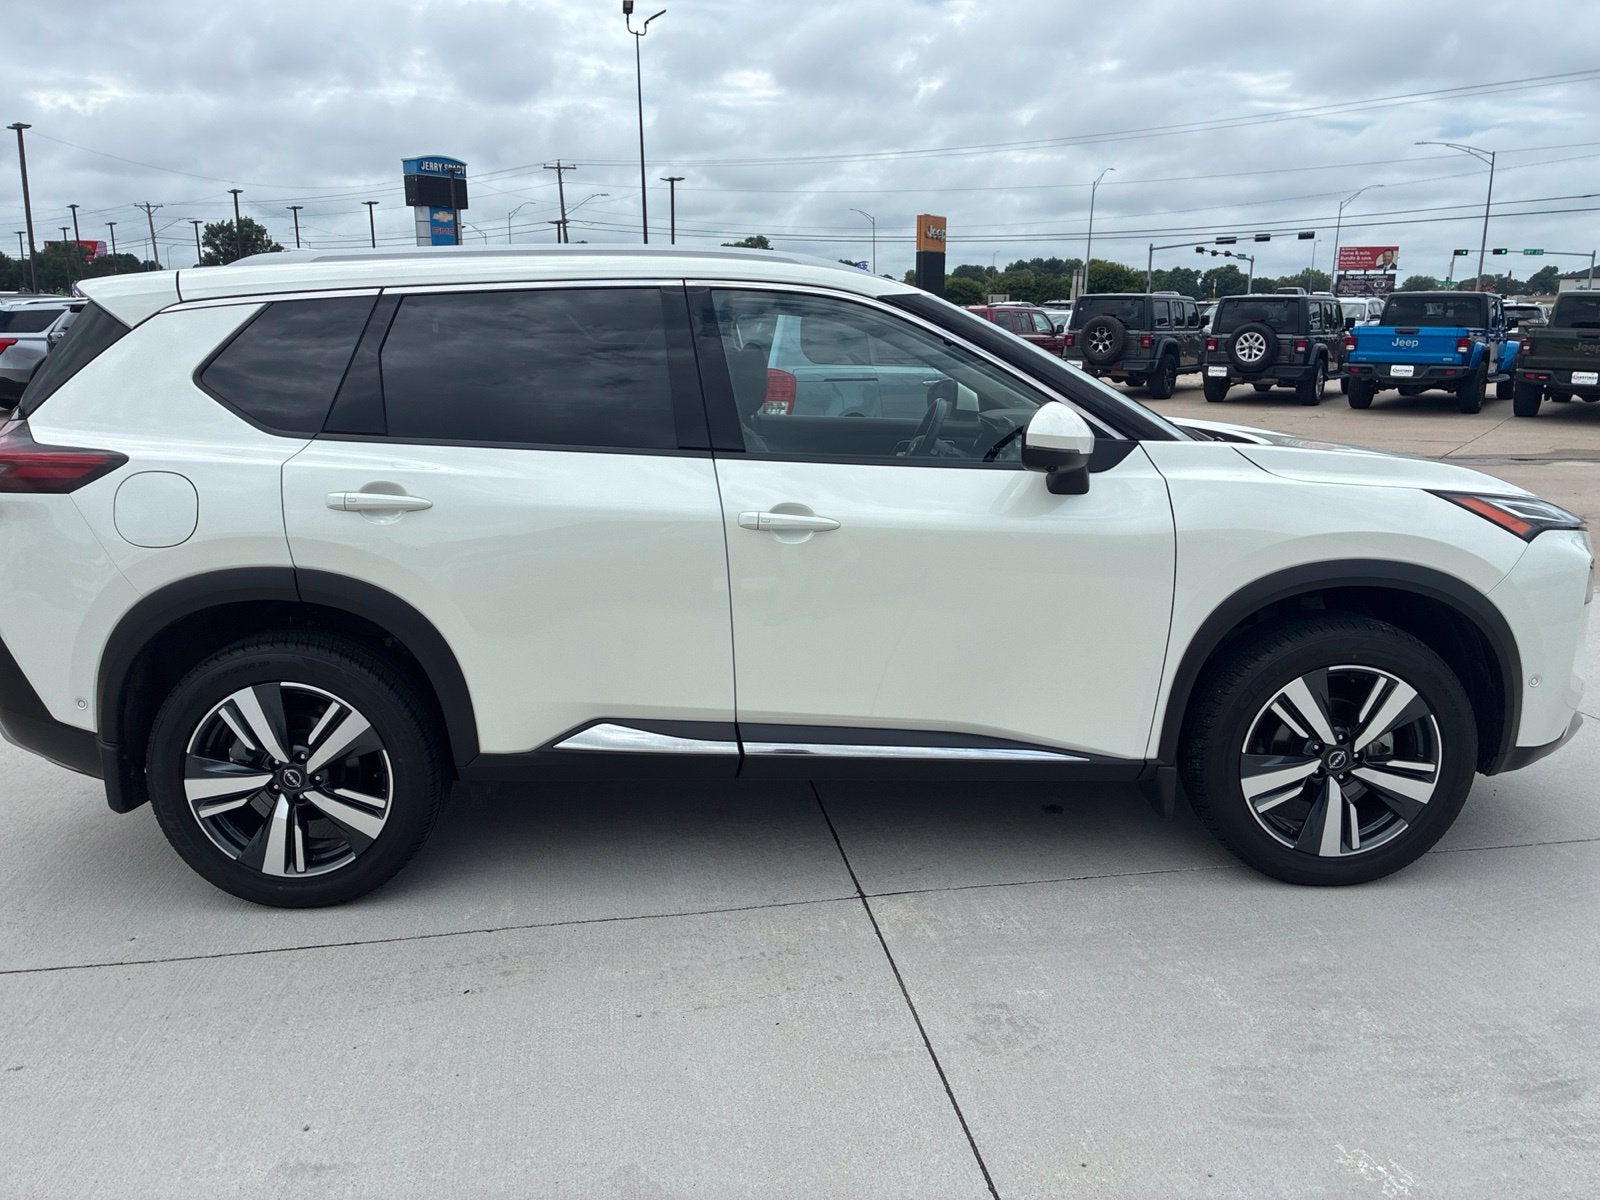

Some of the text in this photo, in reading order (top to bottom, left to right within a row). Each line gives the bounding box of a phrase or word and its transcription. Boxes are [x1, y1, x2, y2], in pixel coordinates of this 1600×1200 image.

[421, 161, 442, 172] JERRY
[926, 224, 946, 240] Jeep
[1391, 338, 1419, 348] Jeep
